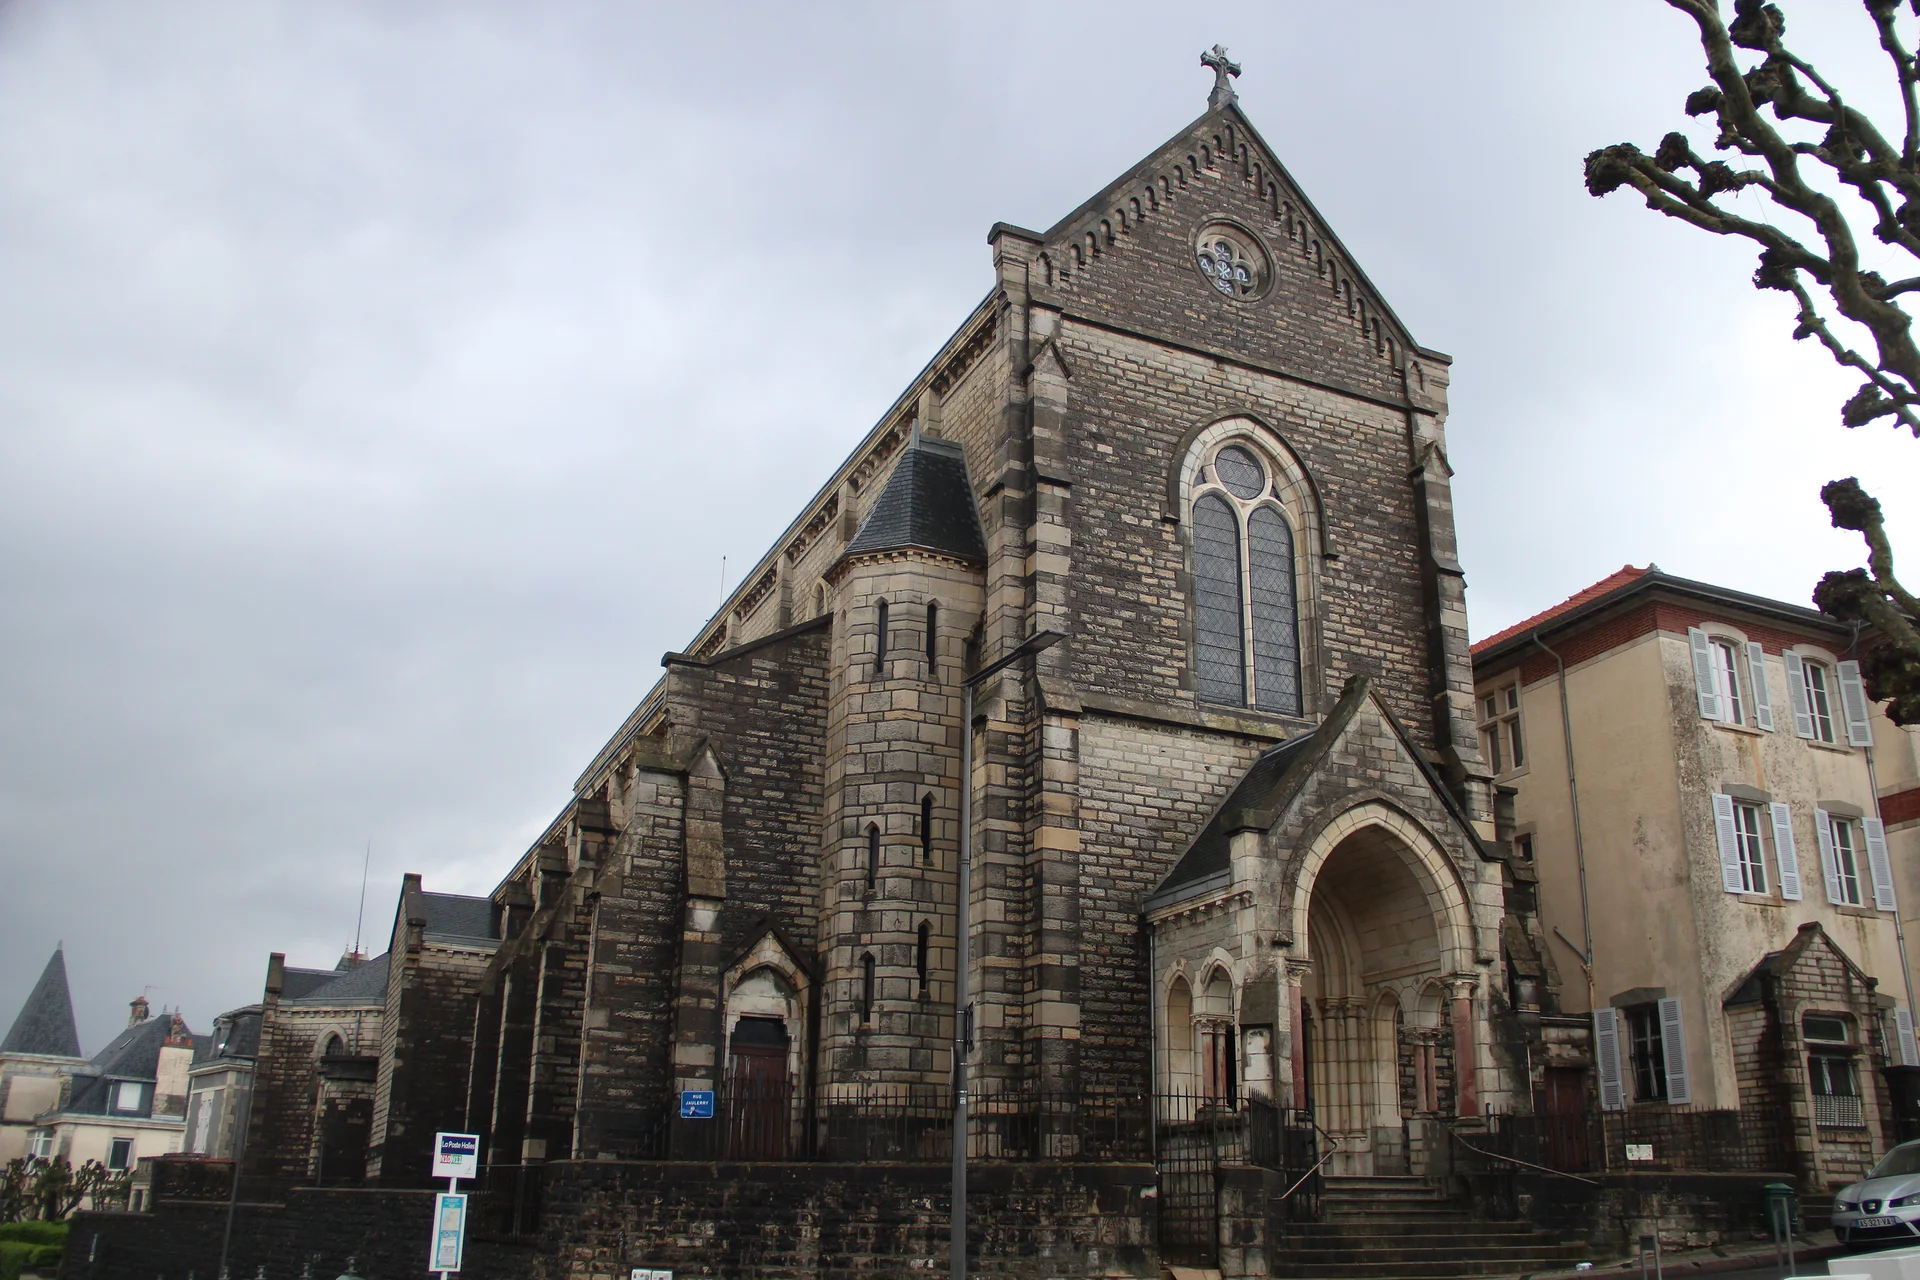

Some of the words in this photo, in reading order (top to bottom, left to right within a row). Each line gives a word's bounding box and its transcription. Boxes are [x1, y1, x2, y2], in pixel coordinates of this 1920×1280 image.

[442, 1140, 448, 1148] La
[448, 1141, 461, 1149] Poste
[461, 1141, 476, 1150] Halles
